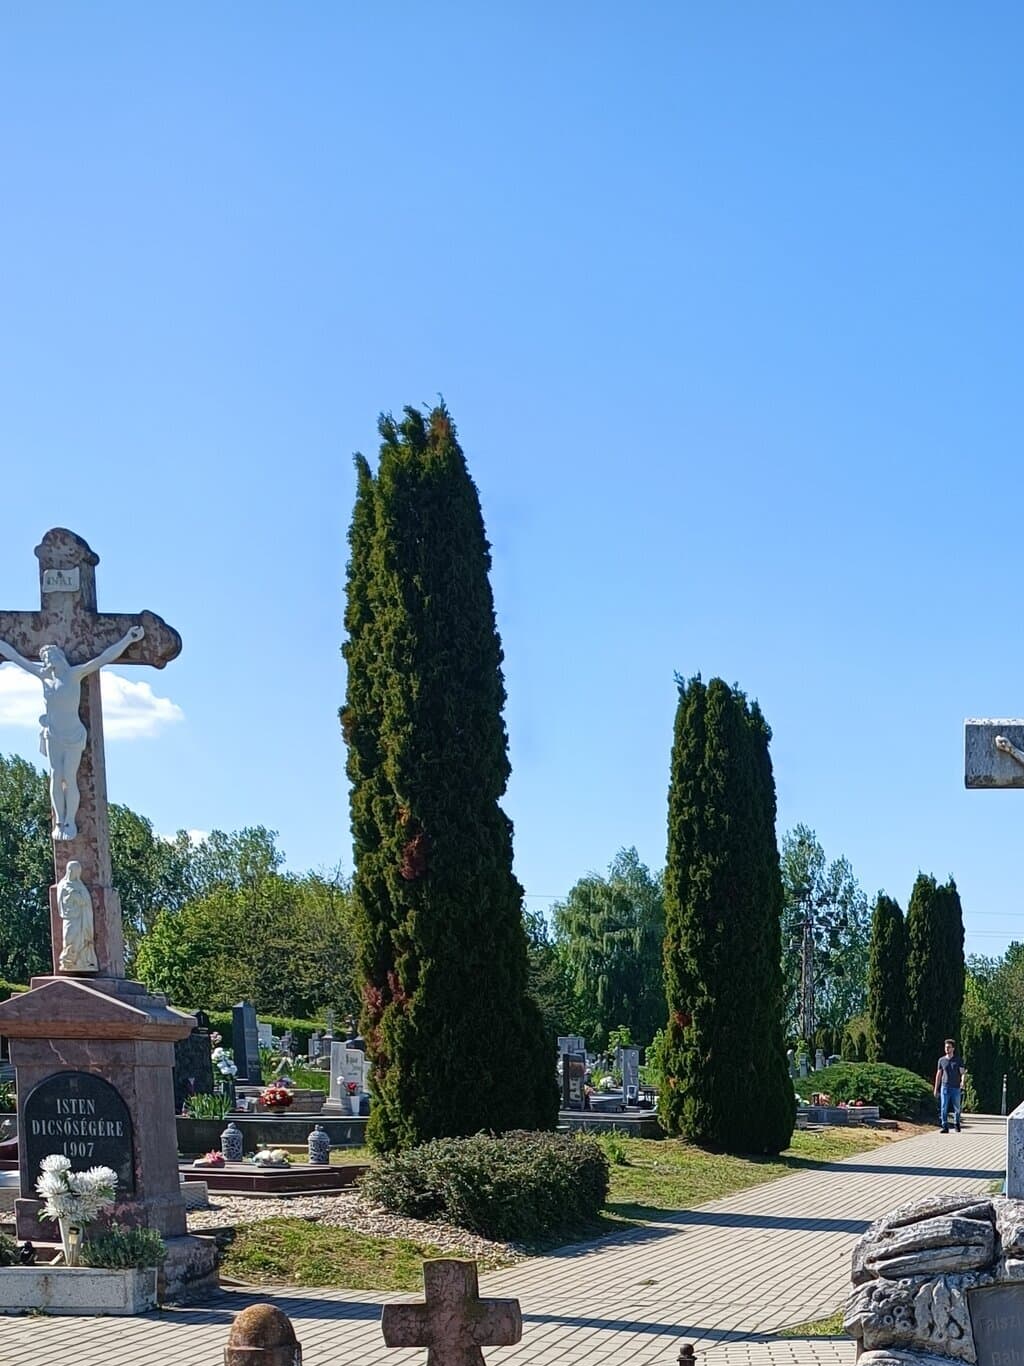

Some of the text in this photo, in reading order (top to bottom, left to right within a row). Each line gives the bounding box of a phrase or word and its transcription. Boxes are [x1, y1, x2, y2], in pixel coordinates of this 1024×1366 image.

[56, 1098, 96, 1115] ISTEN
[32, 1117, 124, 1137] DICSŐSÉGÉRE
[63, 1142, 95, 1158] 1907
